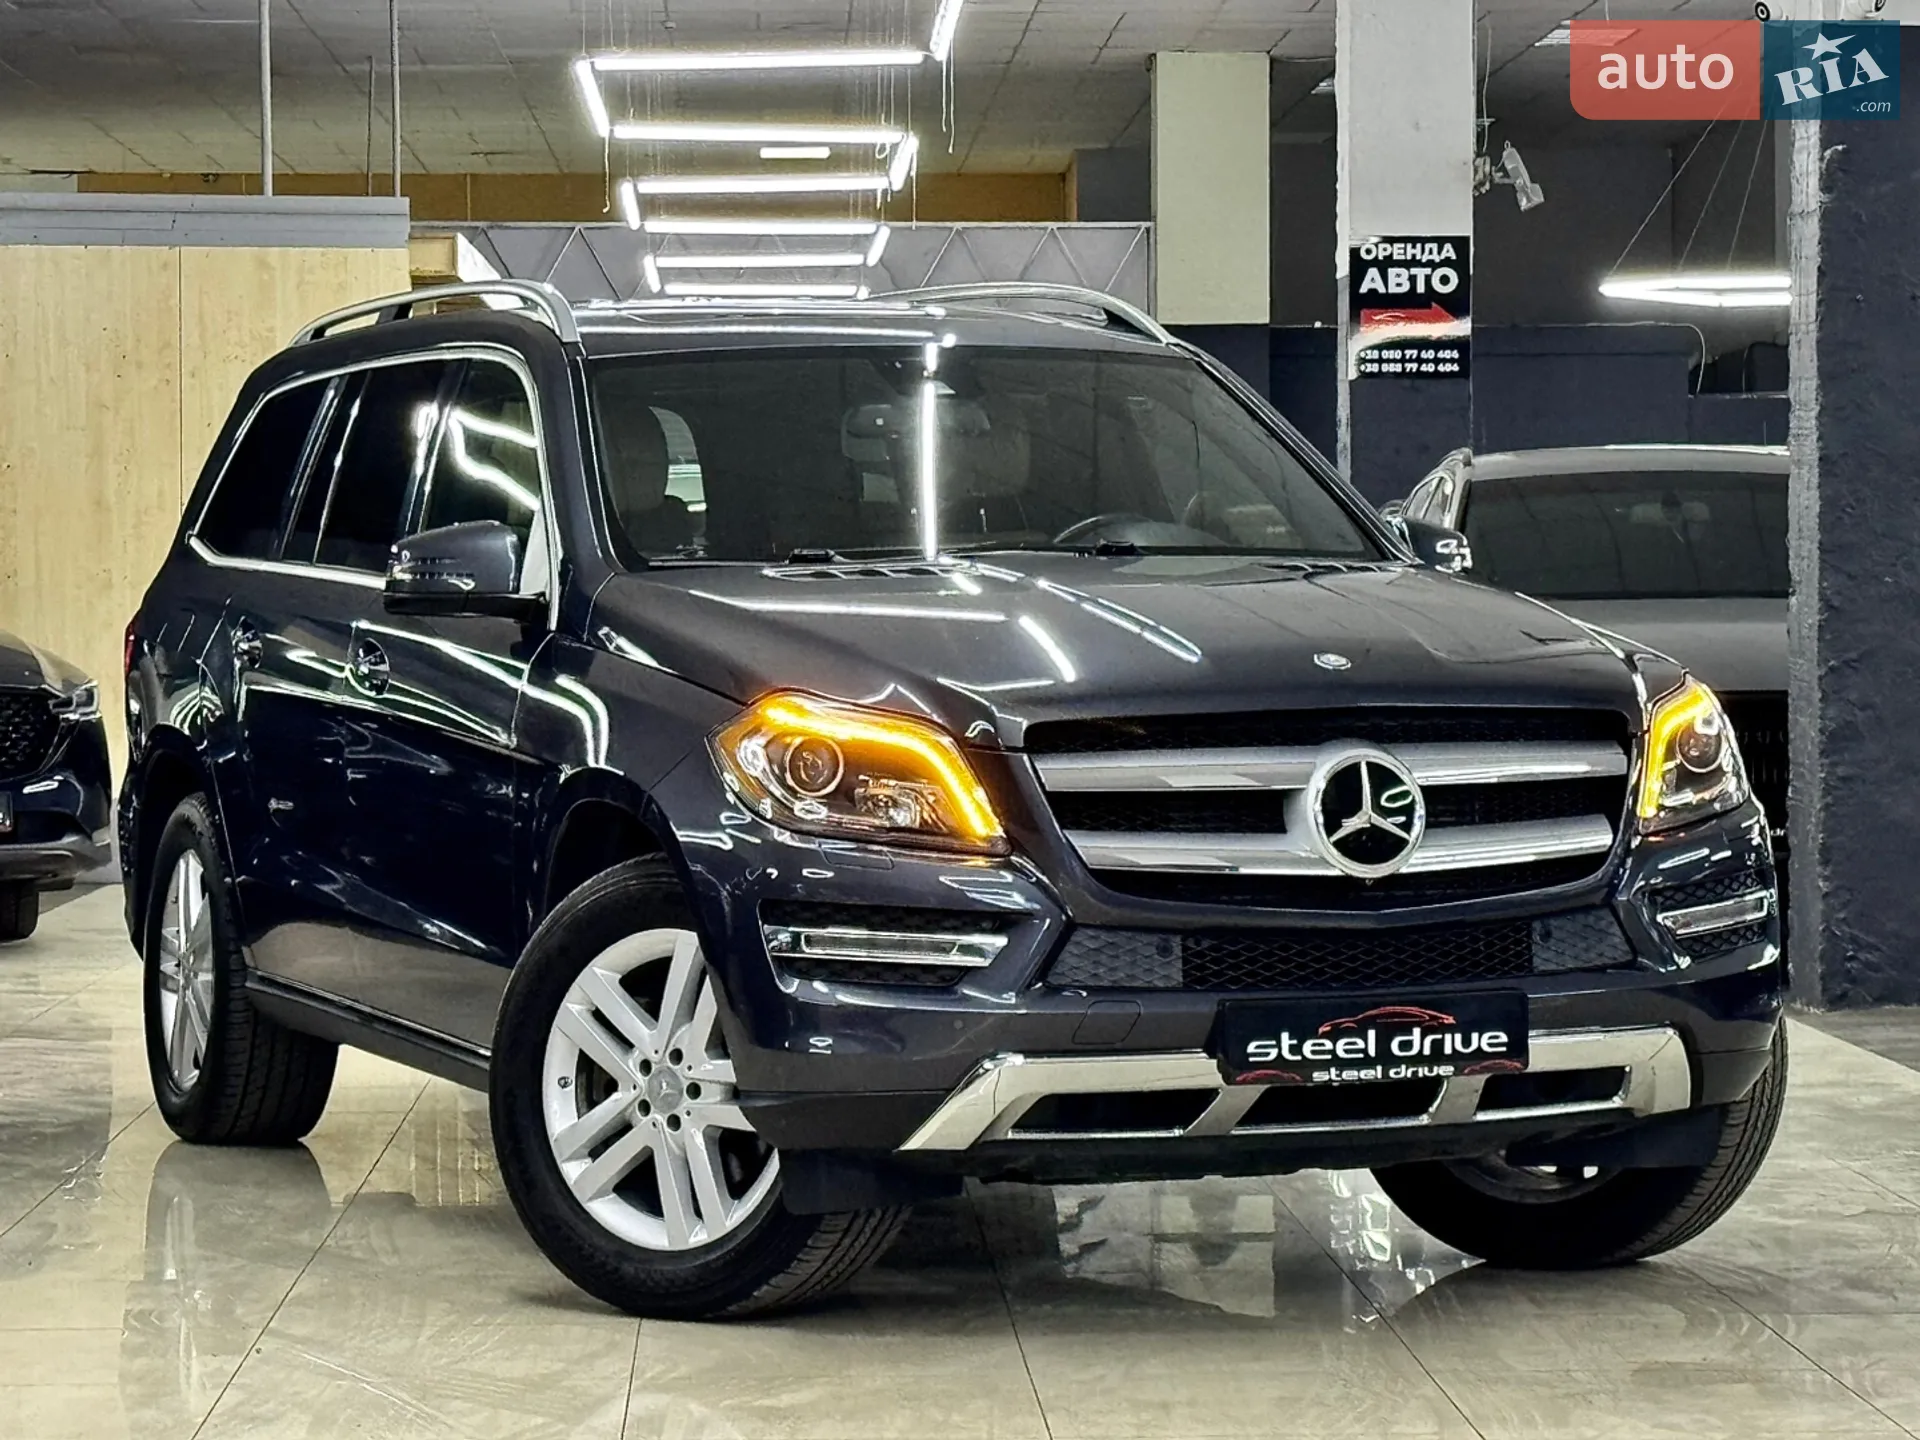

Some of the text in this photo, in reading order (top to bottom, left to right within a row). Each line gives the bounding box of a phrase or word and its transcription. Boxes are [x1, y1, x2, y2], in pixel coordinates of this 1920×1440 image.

[1360, 242, 1457, 263] ОРЕНДА
[1359, 267, 1459, 294] АВТО
[1404, 350, 1418, 359] 77
[1404, 363, 1418, 372] 77
[1246, 1027, 1508, 1063] steel drive
[1312, 1064, 1454, 1082] steel drive
